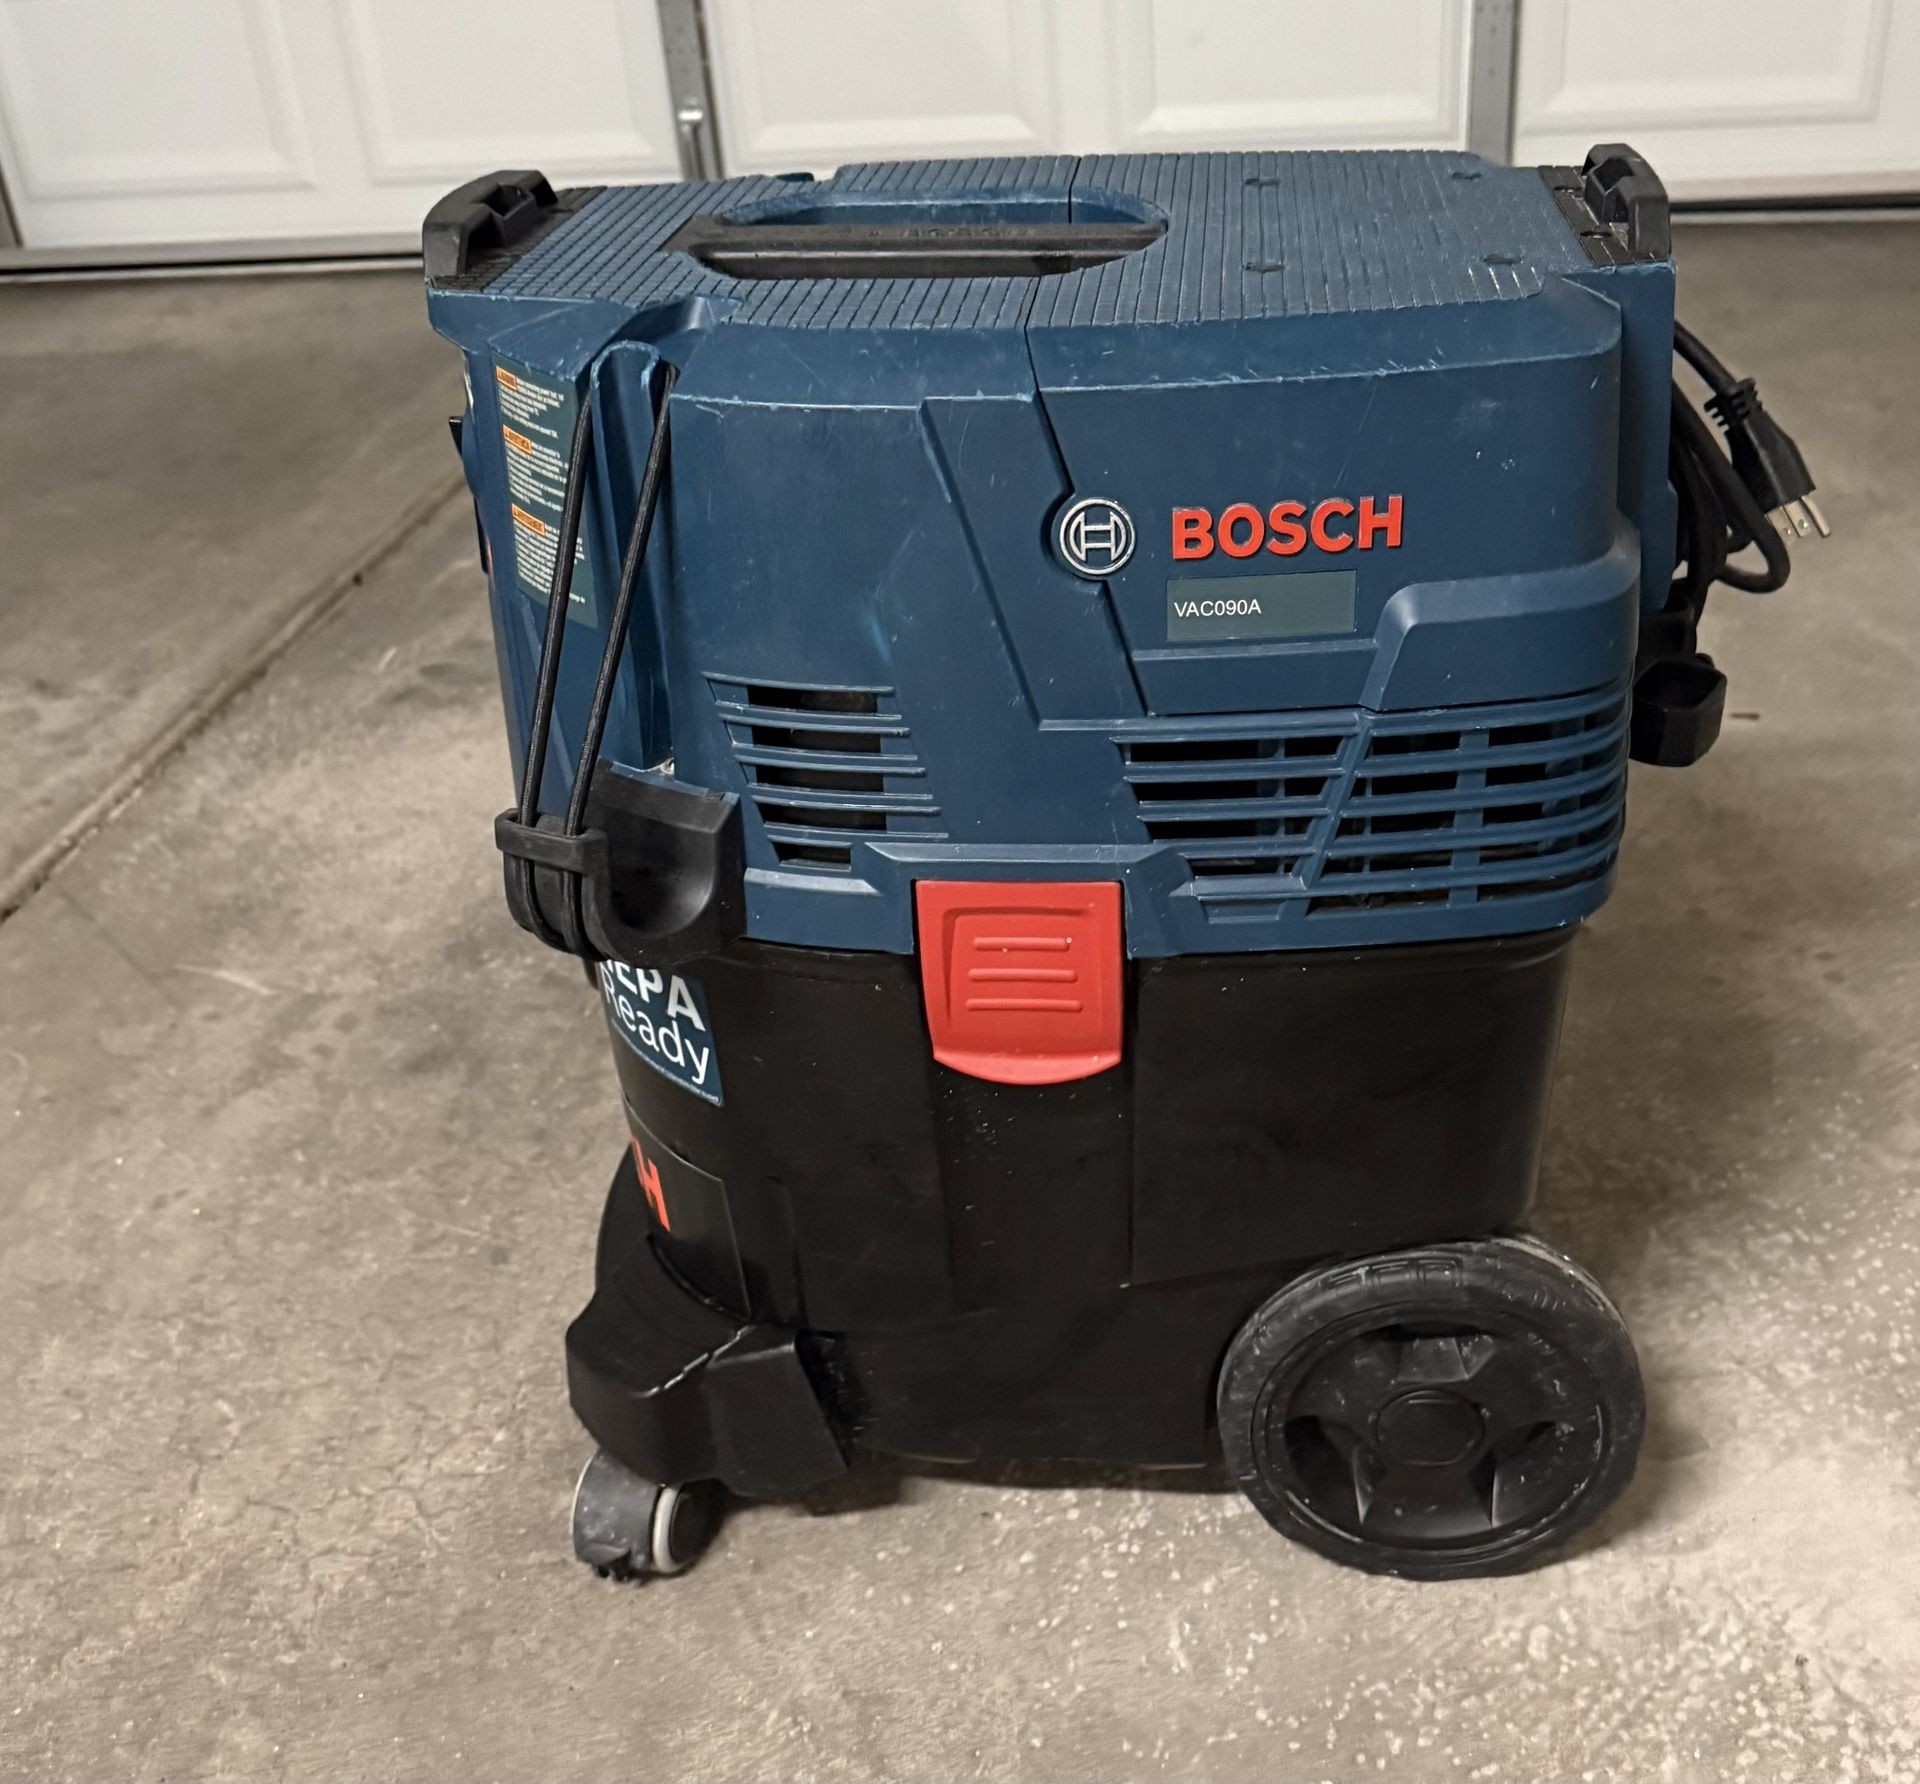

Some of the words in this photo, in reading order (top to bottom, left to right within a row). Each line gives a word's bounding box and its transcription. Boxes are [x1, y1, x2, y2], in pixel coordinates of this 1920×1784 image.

[1172, 494, 1403, 560] BOSCH
[1174, 599, 1262, 618] VAC090A
[600, 962, 709, 1085] Ready
[606, 959, 706, 1032] EPA
